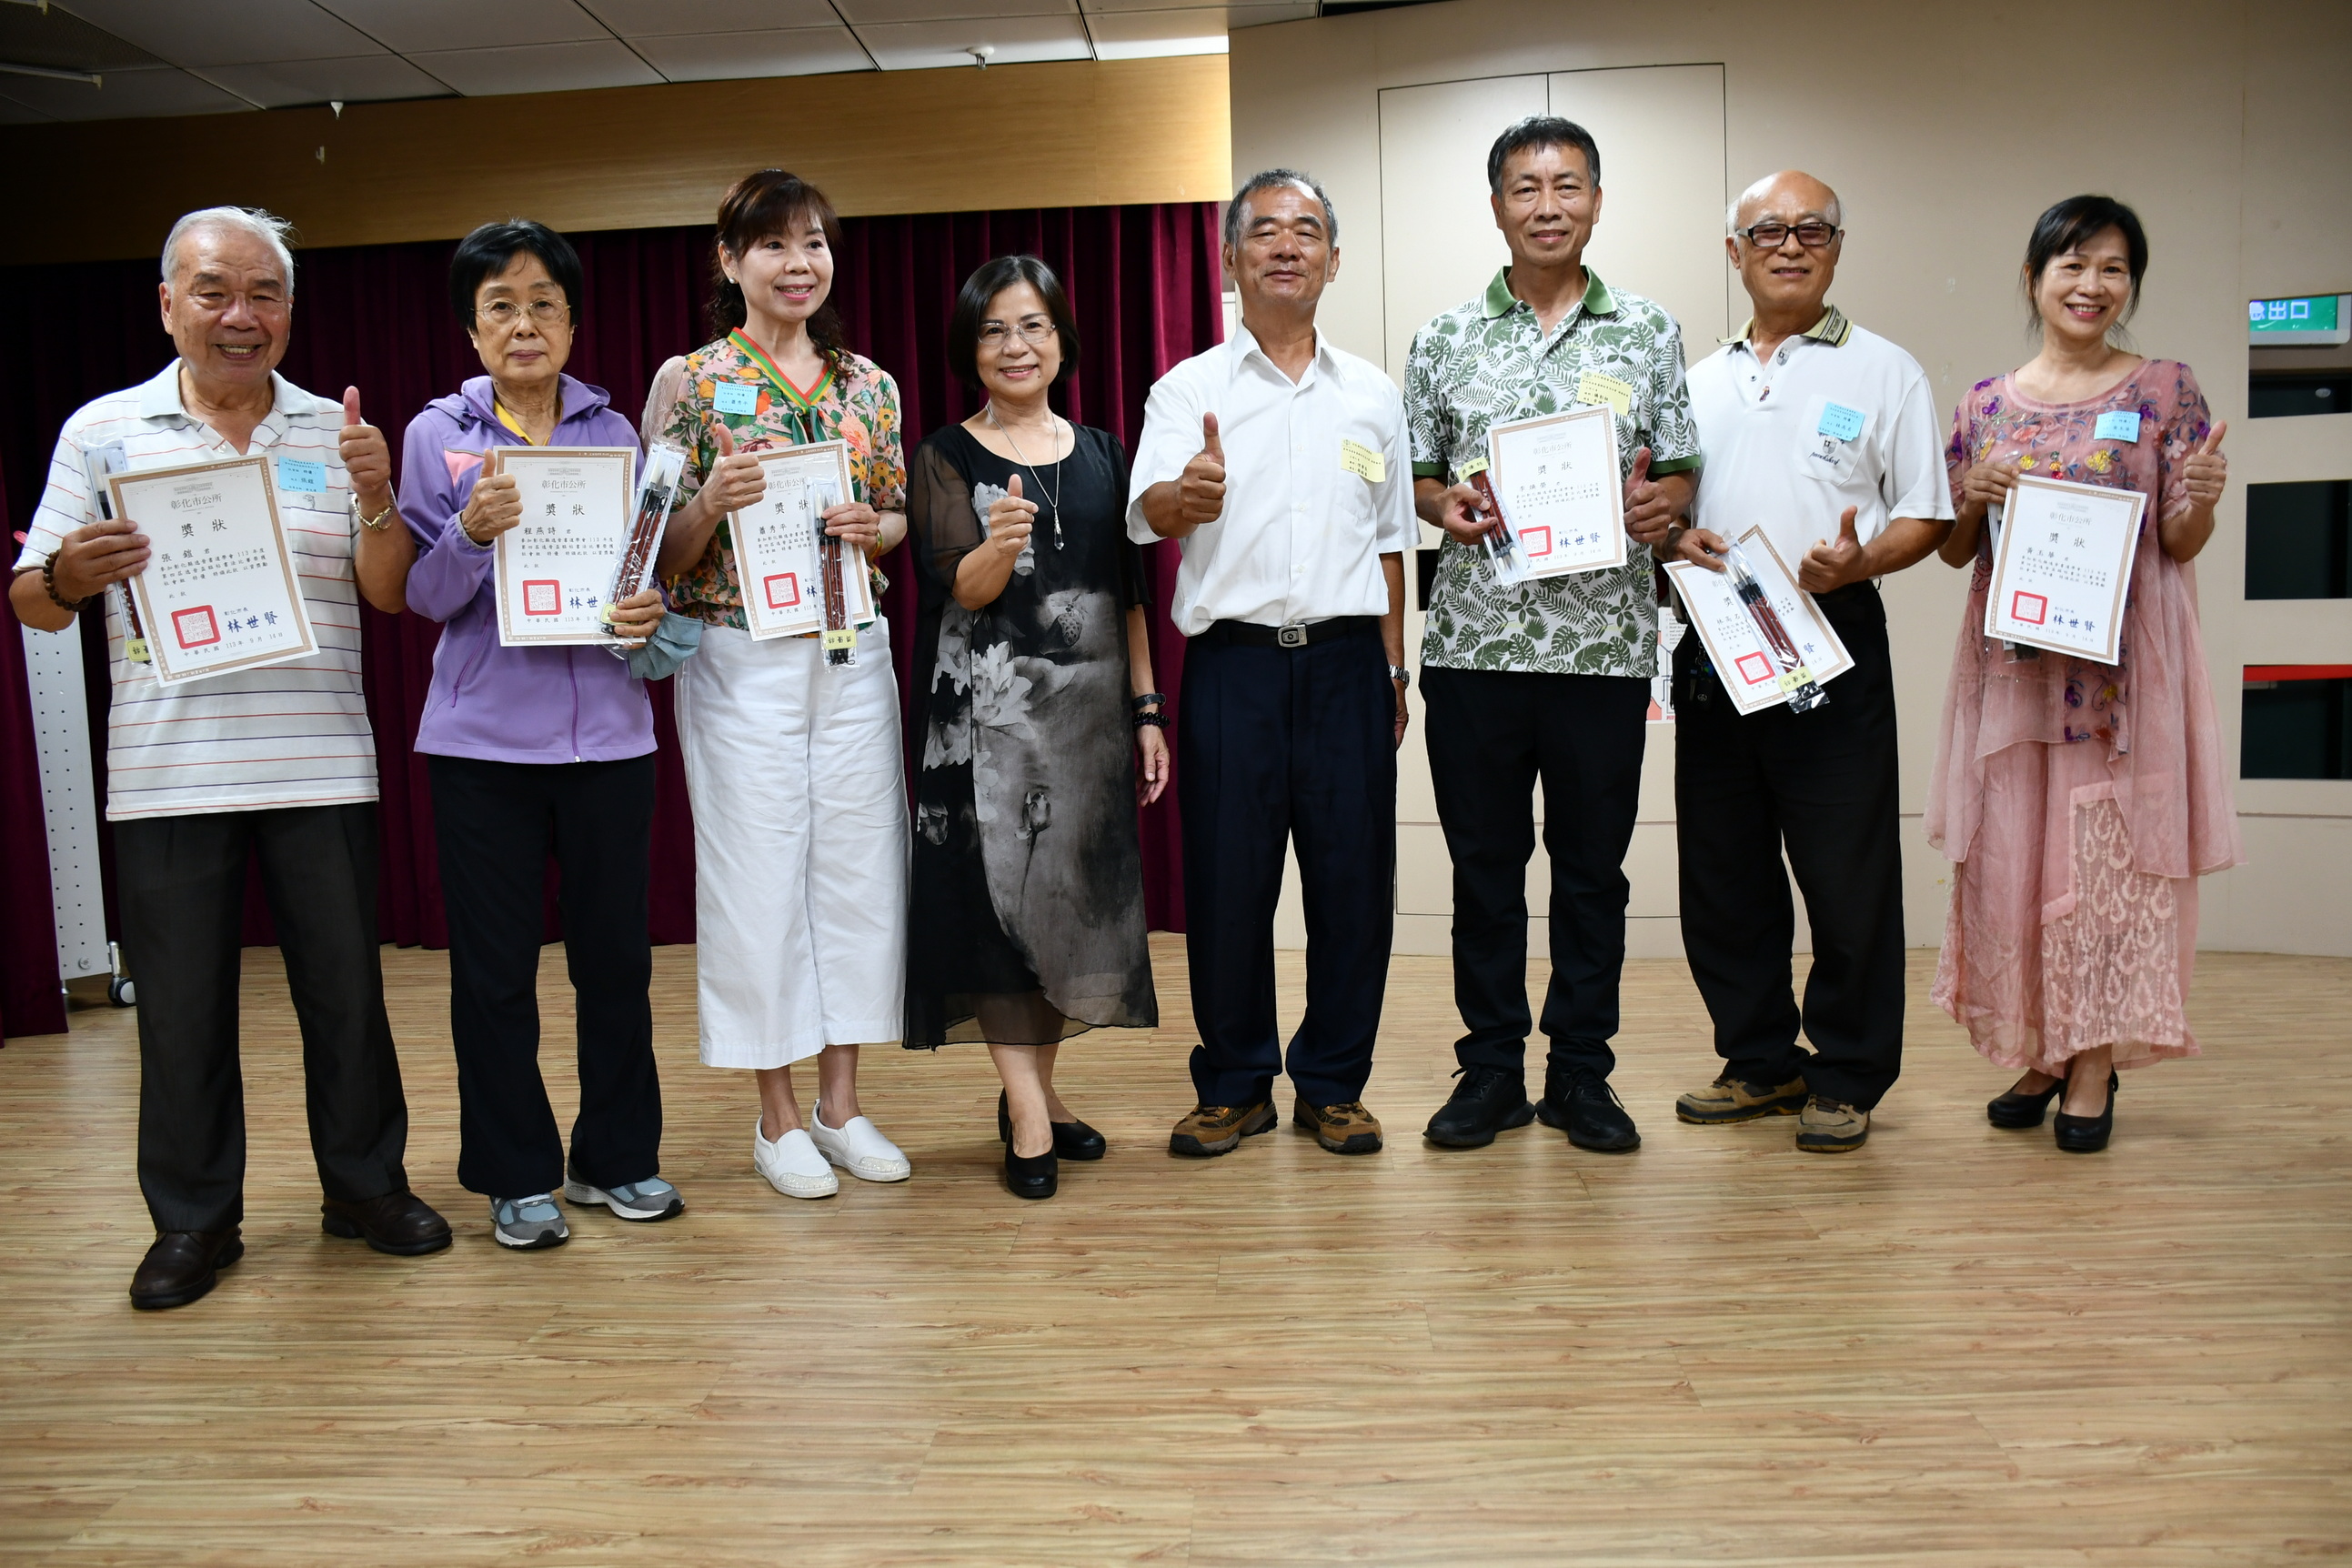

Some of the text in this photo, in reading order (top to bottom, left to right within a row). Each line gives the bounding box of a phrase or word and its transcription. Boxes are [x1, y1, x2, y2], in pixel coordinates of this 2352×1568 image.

[542, 480, 587, 489] 彰化市公所
[170, 493, 222, 509] 彰化市公所
[2049, 512, 2092, 526] 彰化市公所
[1560, 532, 1600, 548] 林世賢
[227, 610, 278, 633] 林世賢
[2053, 614, 2096, 632] 林世賢
